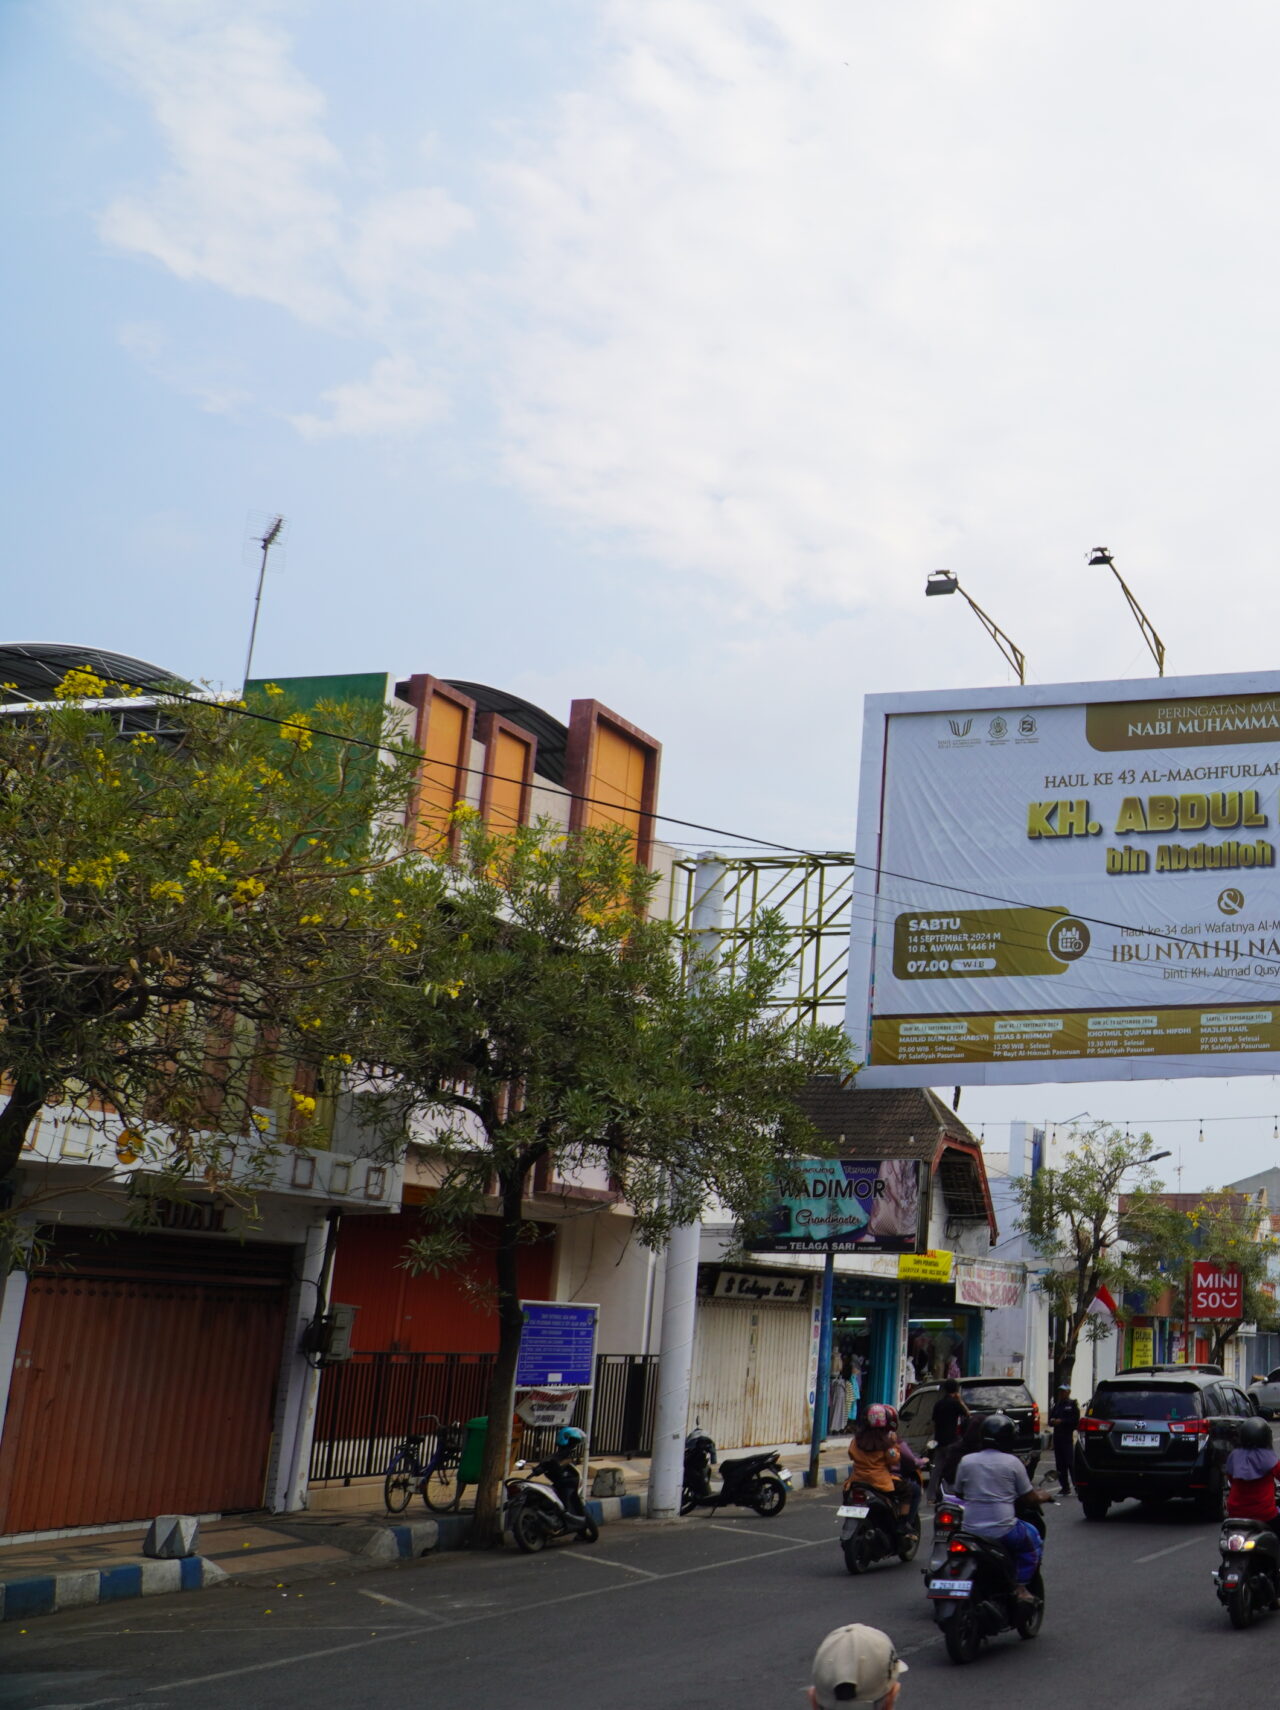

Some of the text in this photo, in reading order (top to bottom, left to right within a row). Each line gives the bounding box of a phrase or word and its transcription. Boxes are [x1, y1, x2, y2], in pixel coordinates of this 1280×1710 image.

[1157, 703, 1246, 720] PERINGATAN
[1127, 720, 1173, 737] NABI
[1044, 773, 1089, 789] HAUL
[1092, 772, 1114, 785] KE
[1117, 769, 1136, 785] 43
[1027, 799, 1102, 839] KH.
[1114, 789, 1268, 835] ABDUL
[1105, 845, 1150, 875] bin
[1155, 839, 1276, 873] Abdulloh
[908, 918, 961, 931] SABTU
[1120, 926, 1145, 938] Haul
[1149, 924, 1178, 936] ke-34
[1180, 923, 1201, 935] dari
[1204, 922, 1255, 935] Wafatnya
[908, 932, 1001, 944] 14 SEPTEMBER 2024 M
[908, 945, 918, 953] 10
[930, 944, 964, 952] AWWAL
[967, 943, 986, 951] 1446
[988, 942, 996, 950] H
[1112, 943, 1150, 963] IBU
[1155, 940, 1209, 961] NYAI
[906, 959, 950, 973] 07.00
[1163, 967, 1188, 979] binti
[1191, 967, 1210, 978] KH.
[1213, 965, 1251, 977] Ahmad
[1087, 1030, 1122, 1038] KHOTMUL
[1228, 1025, 1249, 1033] HAUL
[1104, 1039, 1118, 1047] WIB
[1211, 1043, 1240, 1052] Salafiyah
[1241, 1042, 1270, 1050] Pasuruan
[908, 1052, 936, 1061] Salafiyah
[937, 1051, 965, 1059] Pasuruan
[1097, 1046, 1126, 1056] Salafiyah
[1126, 1046, 1155, 1054] Pasuruan
[779, 1178, 887, 1199] WADIMOR
[795, 1208, 861, 1227] Grandmaster
[789, 1241, 829, 1251] TELAGA
[831, 1241, 856, 1251] SARI
[1196, 1273, 1238, 1289] MINI
